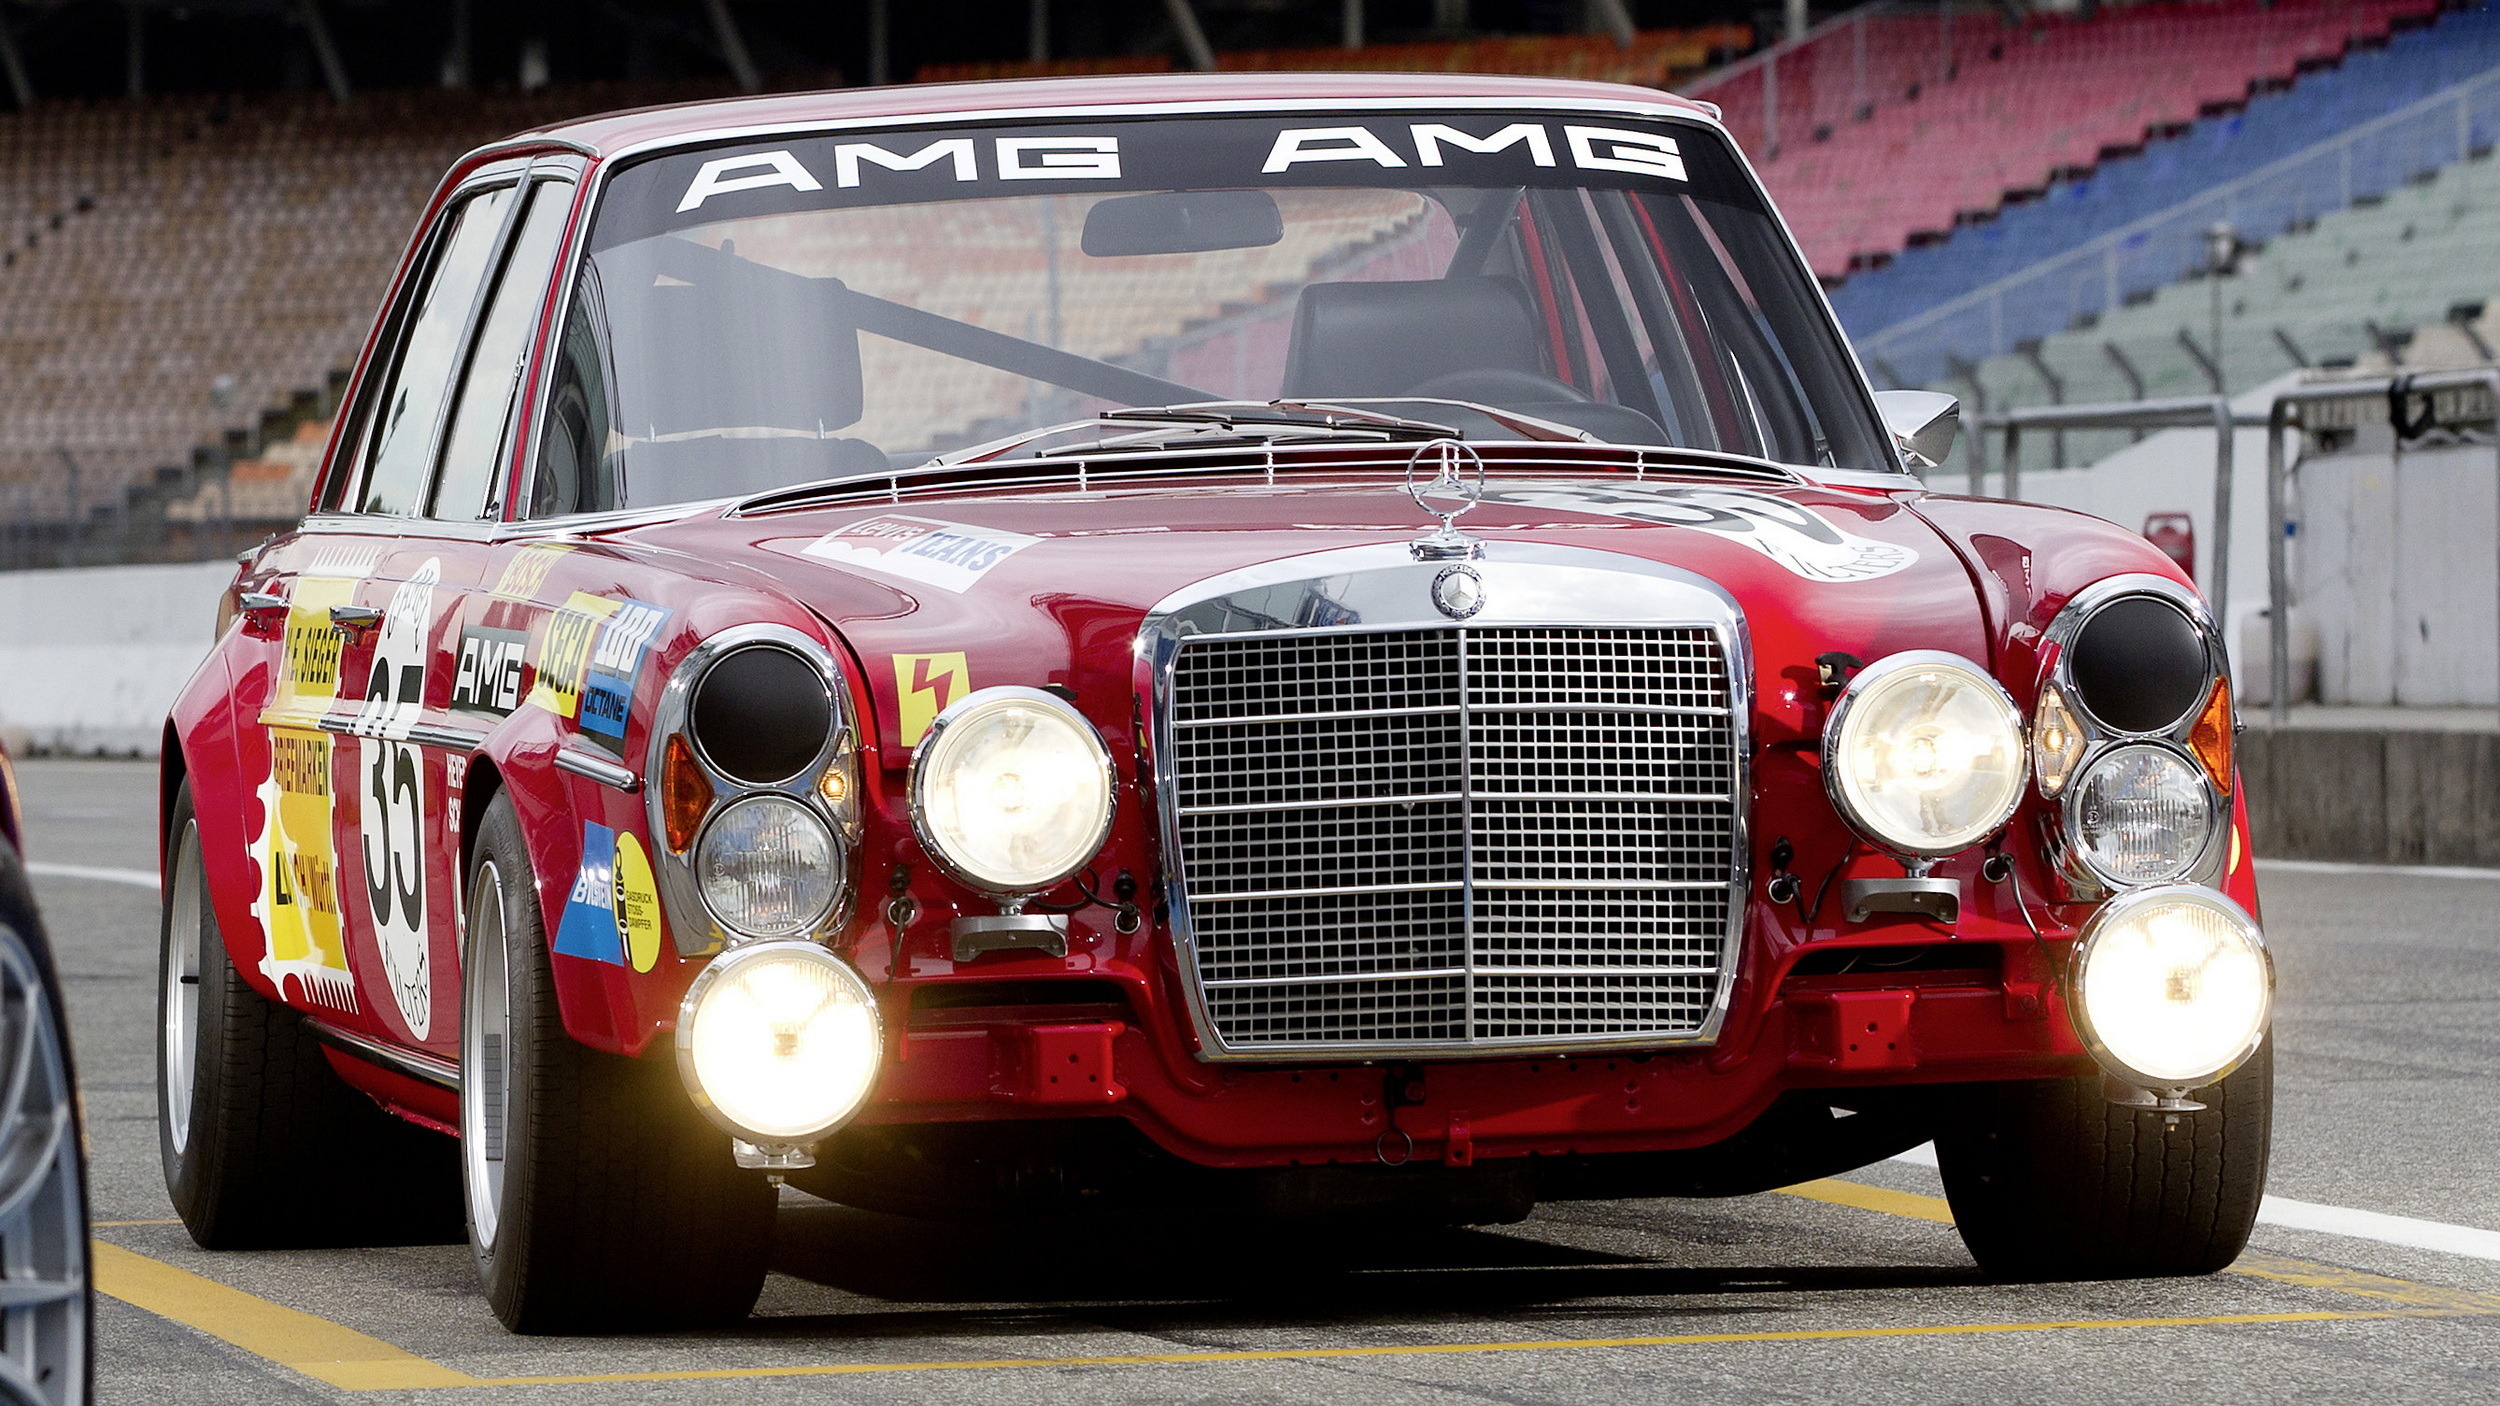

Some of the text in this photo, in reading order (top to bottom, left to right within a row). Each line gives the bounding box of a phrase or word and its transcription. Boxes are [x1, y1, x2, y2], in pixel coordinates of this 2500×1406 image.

[676, 123, 1689, 213] AMG AMG
[901, 532, 1013, 572] JEANS
[301, 627, 341, 684] SIEGER
[453, 638, 526, 711] AMG
[539, 608, 593, 696] SECA
[594, 603, 665, 674] 100
[584, 685, 628, 723] OCTANE
[362, 656, 425, 933] 35
